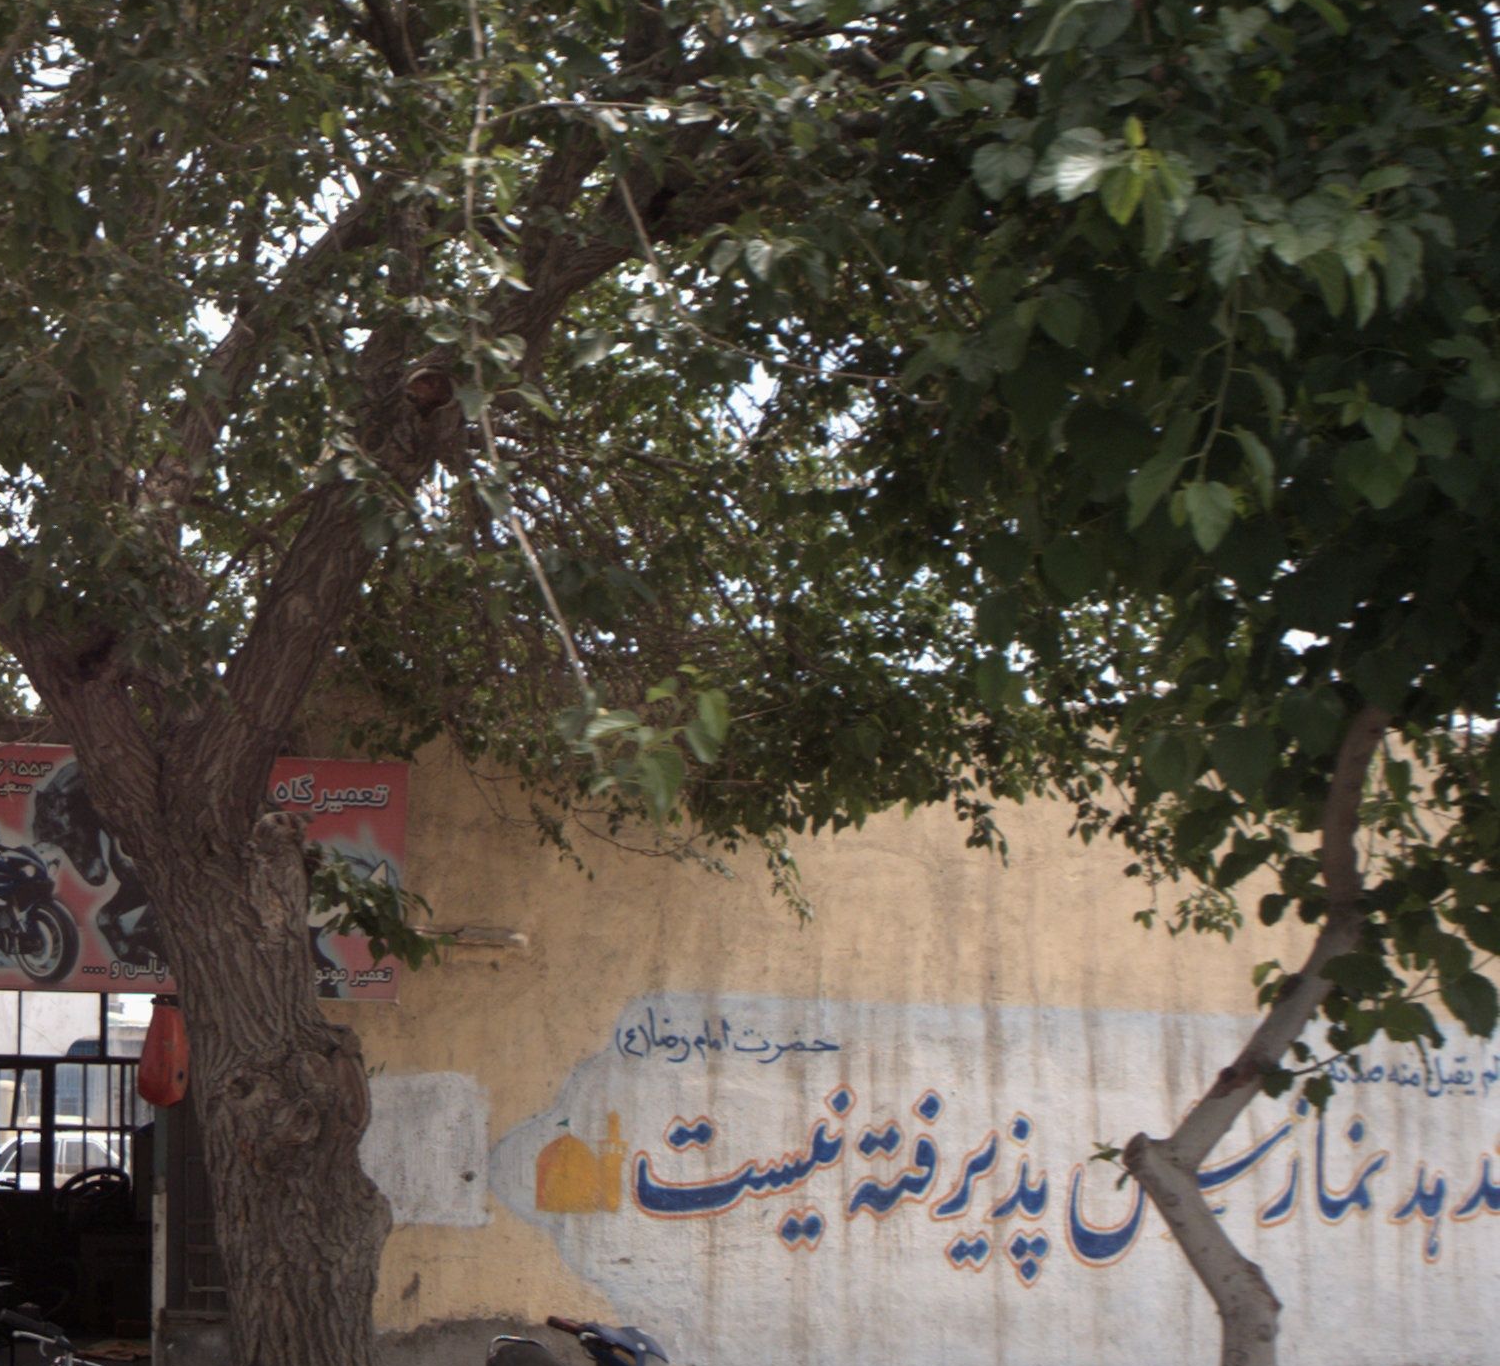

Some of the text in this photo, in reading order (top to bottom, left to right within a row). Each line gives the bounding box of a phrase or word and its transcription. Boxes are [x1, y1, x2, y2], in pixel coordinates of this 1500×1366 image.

[314, 966, 394, 988] تعمیر موتو
[693, 1018, 731, 1062] امام
[734, 1030, 841, 1064] حضرت
[632, 1083, 858, 1252] نیست
[846, 1089, 1053, 1288] پذیرفته
